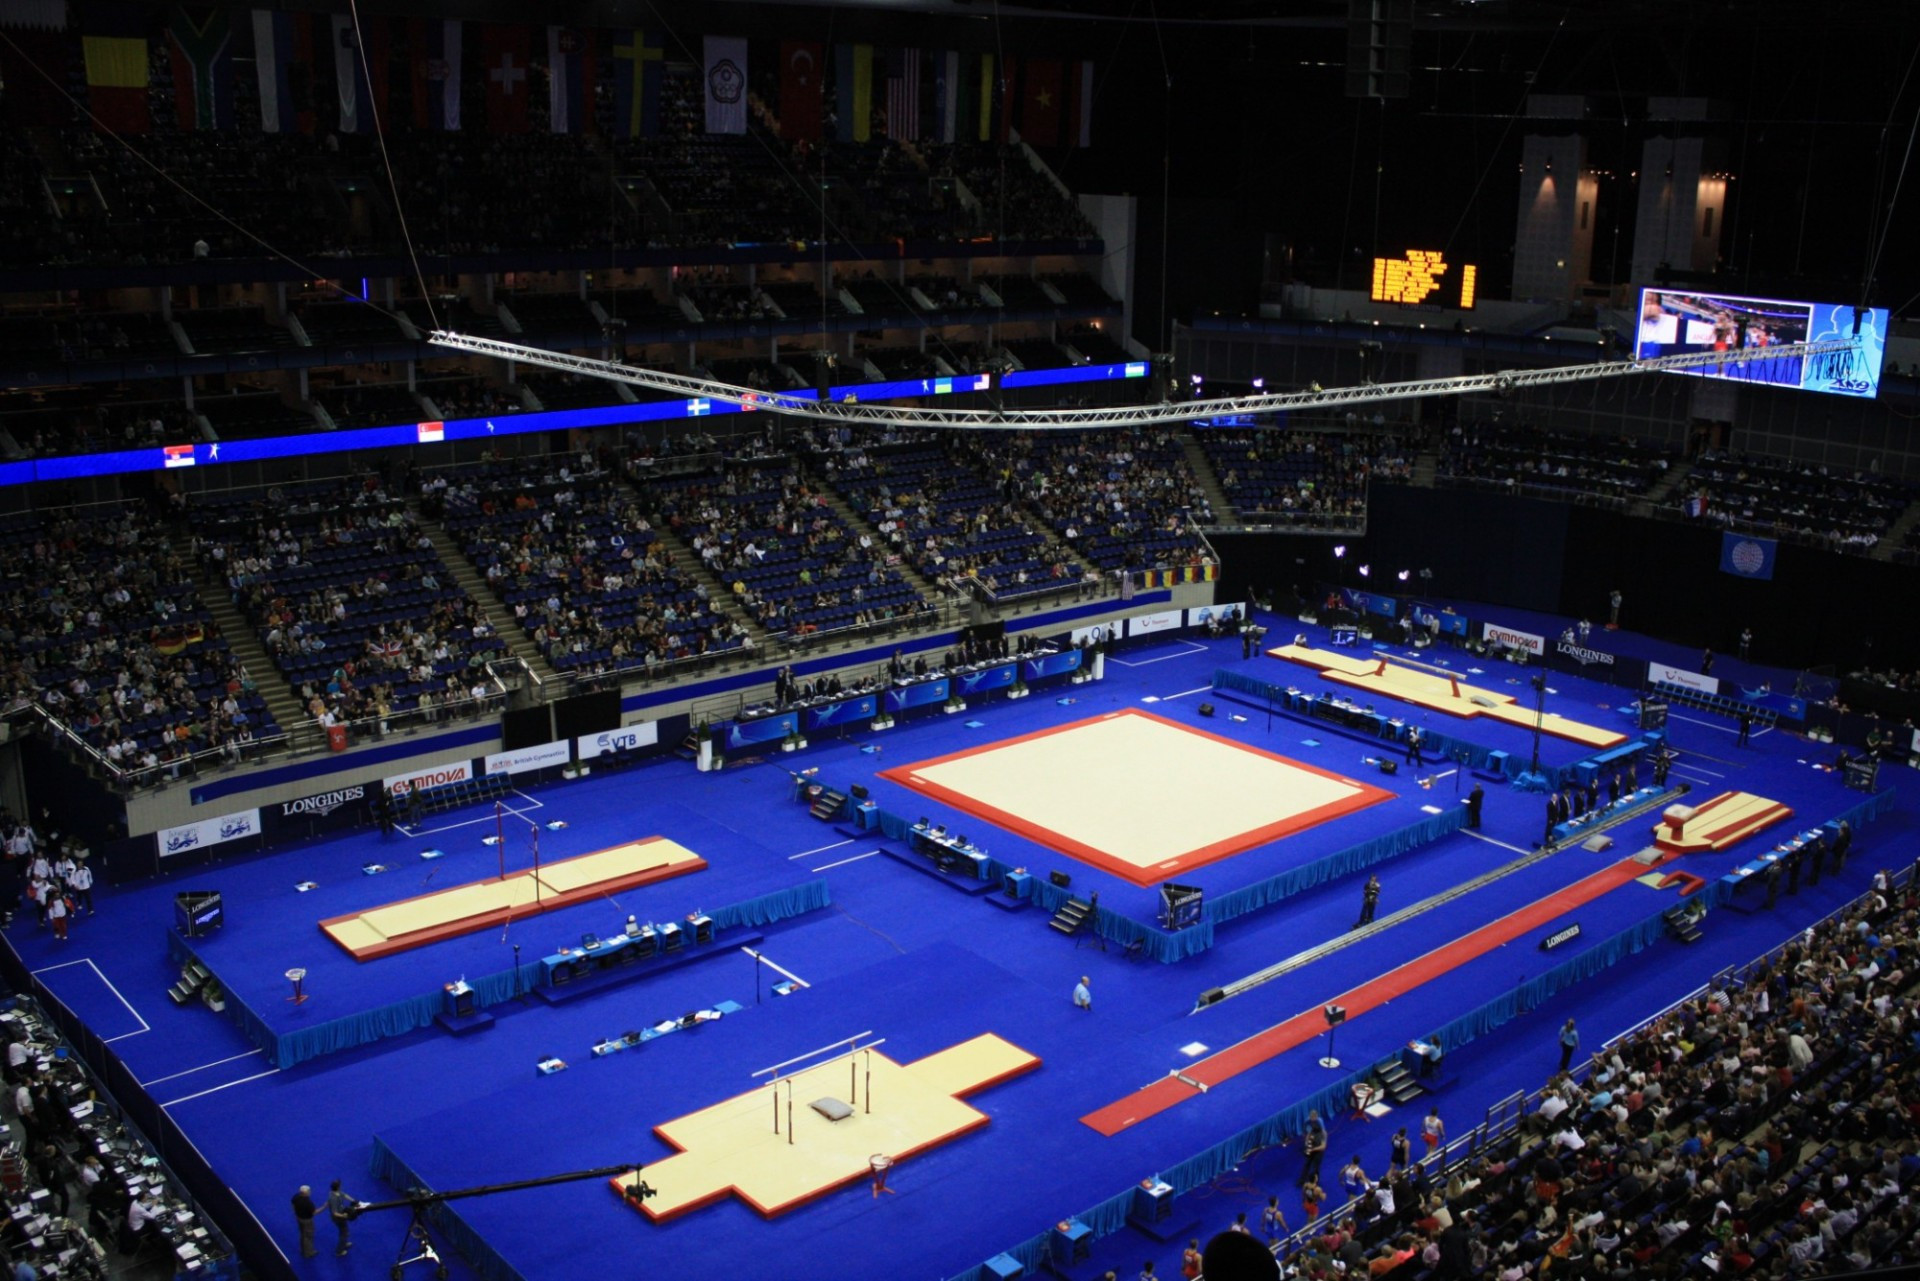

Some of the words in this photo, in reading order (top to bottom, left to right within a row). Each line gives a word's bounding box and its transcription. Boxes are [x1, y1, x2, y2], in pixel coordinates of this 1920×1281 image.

[1557, 642, 1615, 665] LONGINES
[611, 733, 637, 750] VTB
[514, 756, 533, 766] British
[533, 749, 566, 762] Gymnastics
[282, 785, 365, 816] LONGINES
[1546, 924, 1581, 949] LONGINES
